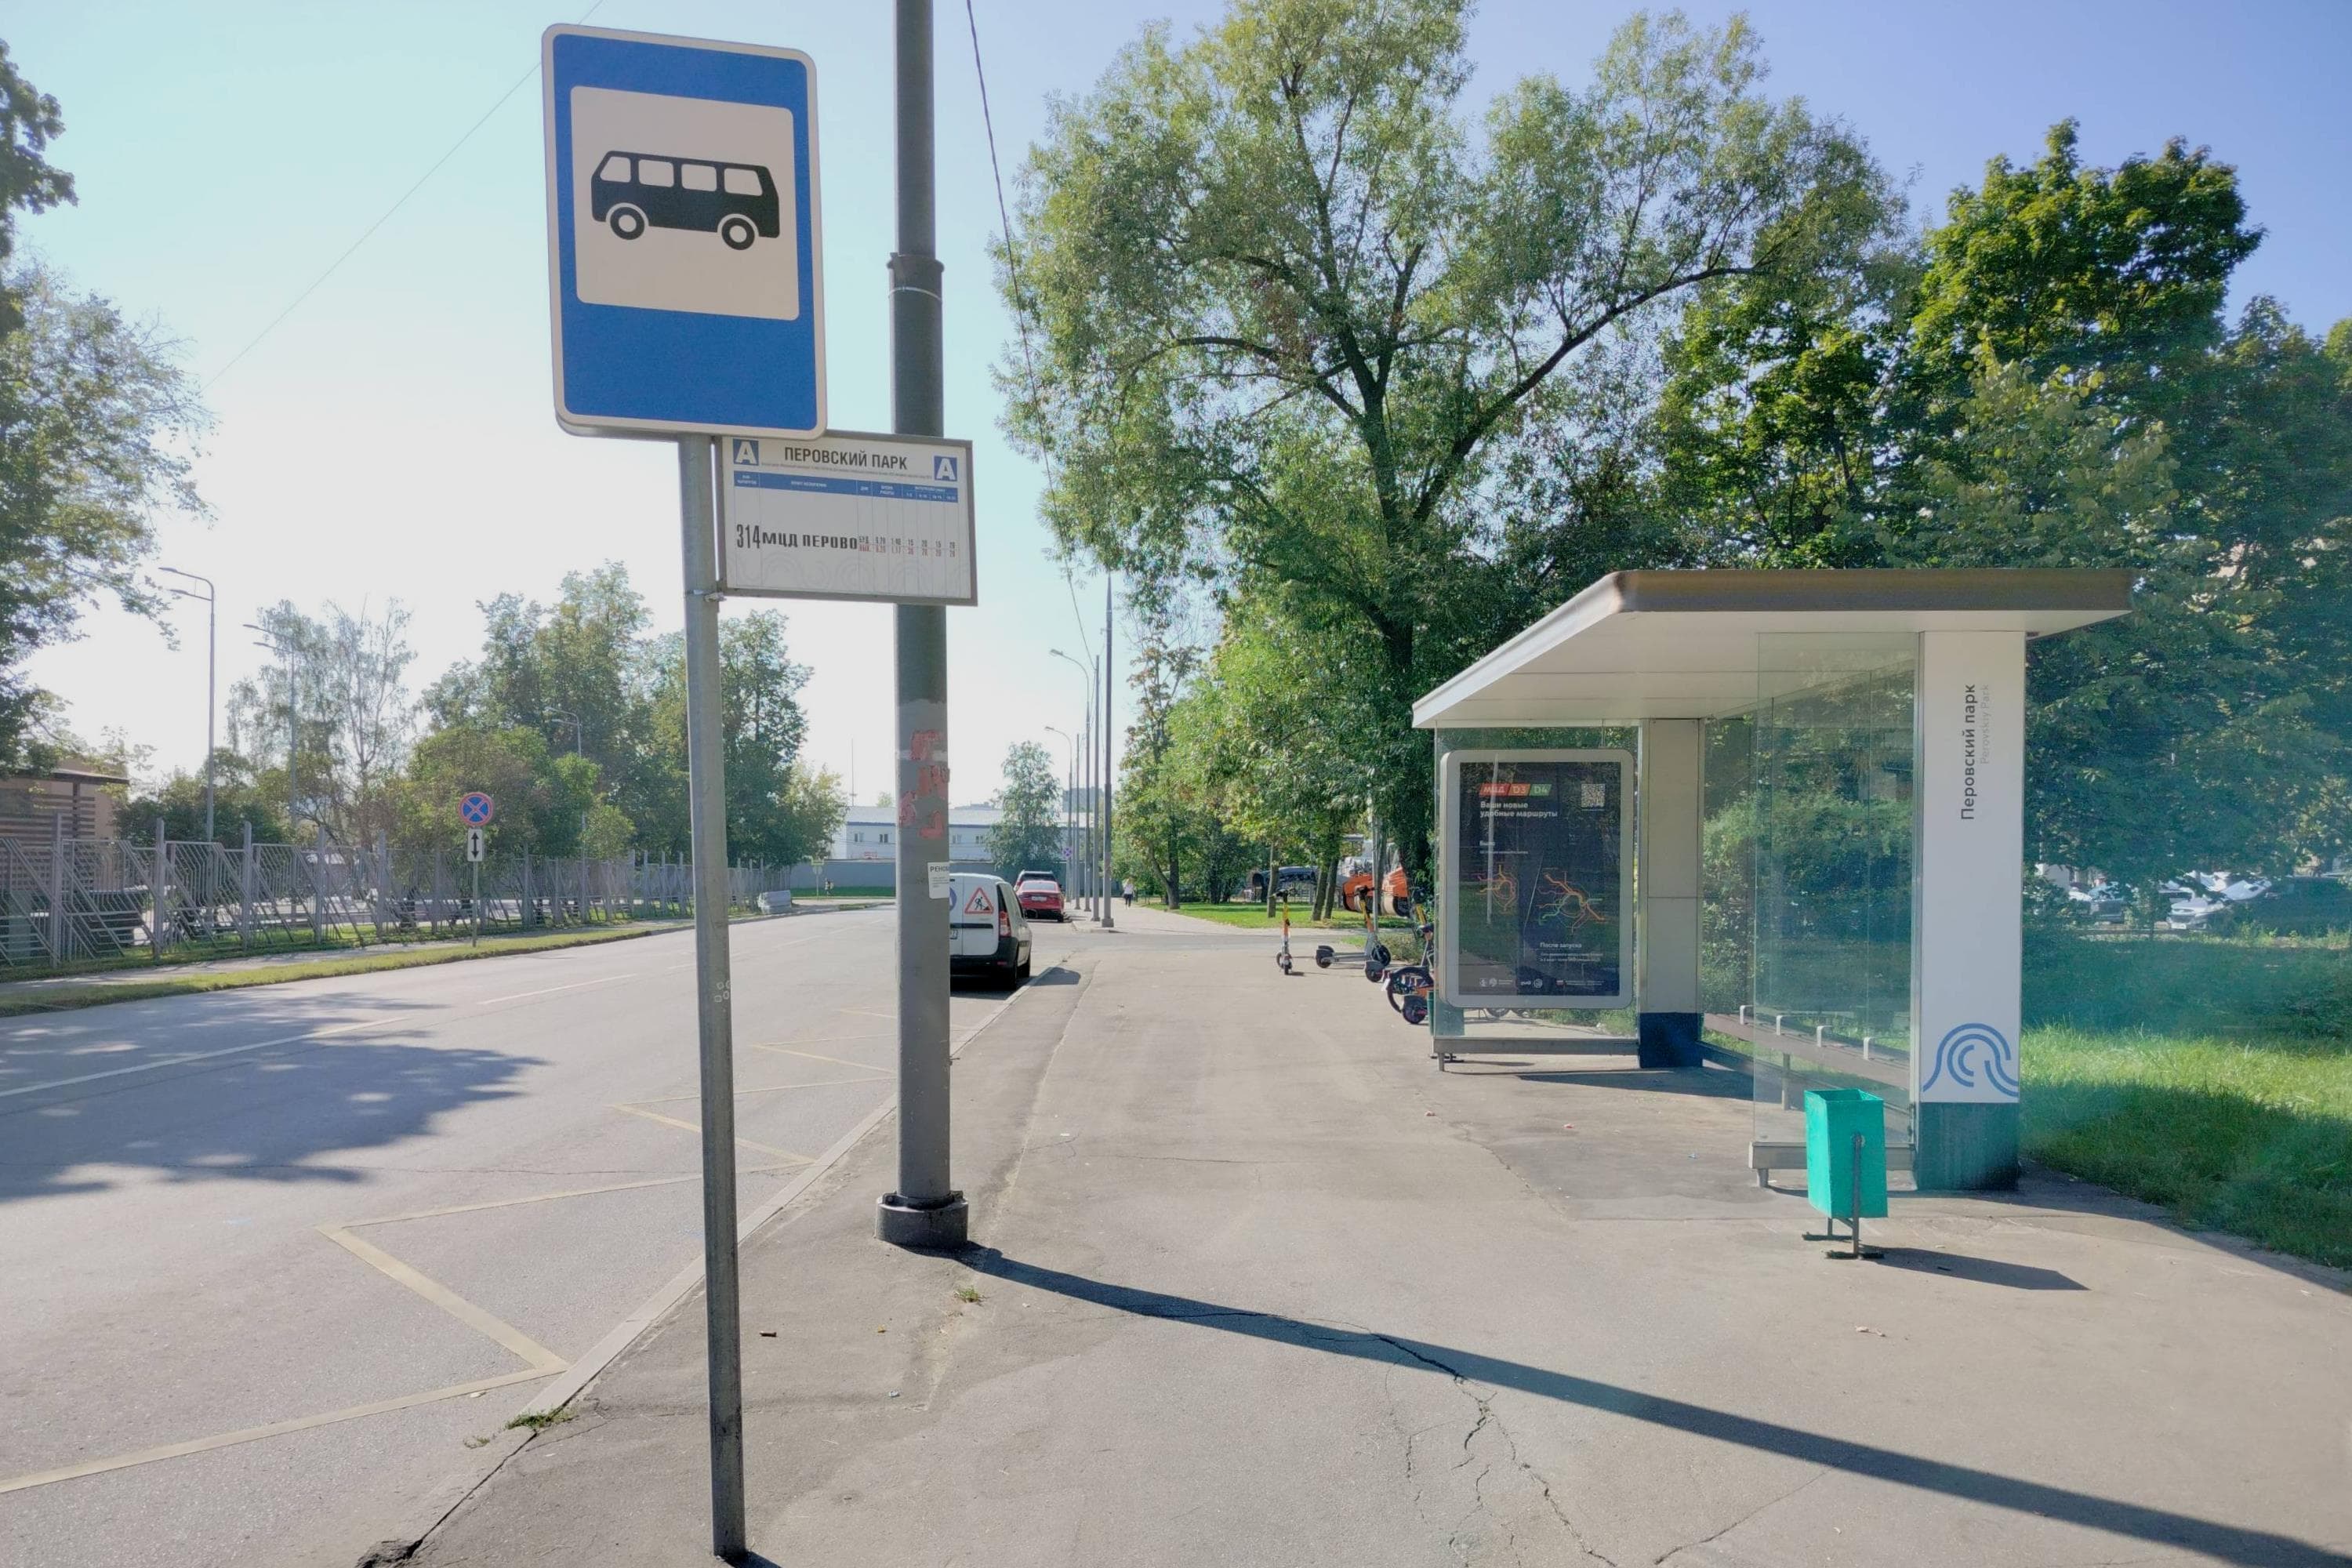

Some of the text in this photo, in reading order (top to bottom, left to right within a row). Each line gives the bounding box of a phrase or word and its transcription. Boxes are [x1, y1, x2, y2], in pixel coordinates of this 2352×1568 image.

[785, 447, 908, 470] ПЕРОВСКИЙ ПАРК
[736, 524, 760, 549] 314
[762, 532, 798, 548] МЦД
[802, 534, 858, 550] ПЕРОВО
[1980, 684, 1991, 764] Perovskiy Park
[1961, 684, 1978, 820] Перовский парк
[1513, 785, 1526, 793] D3
[1534, 785, 1548, 793] D4
[1479, 810, 1515, 818] удобные
